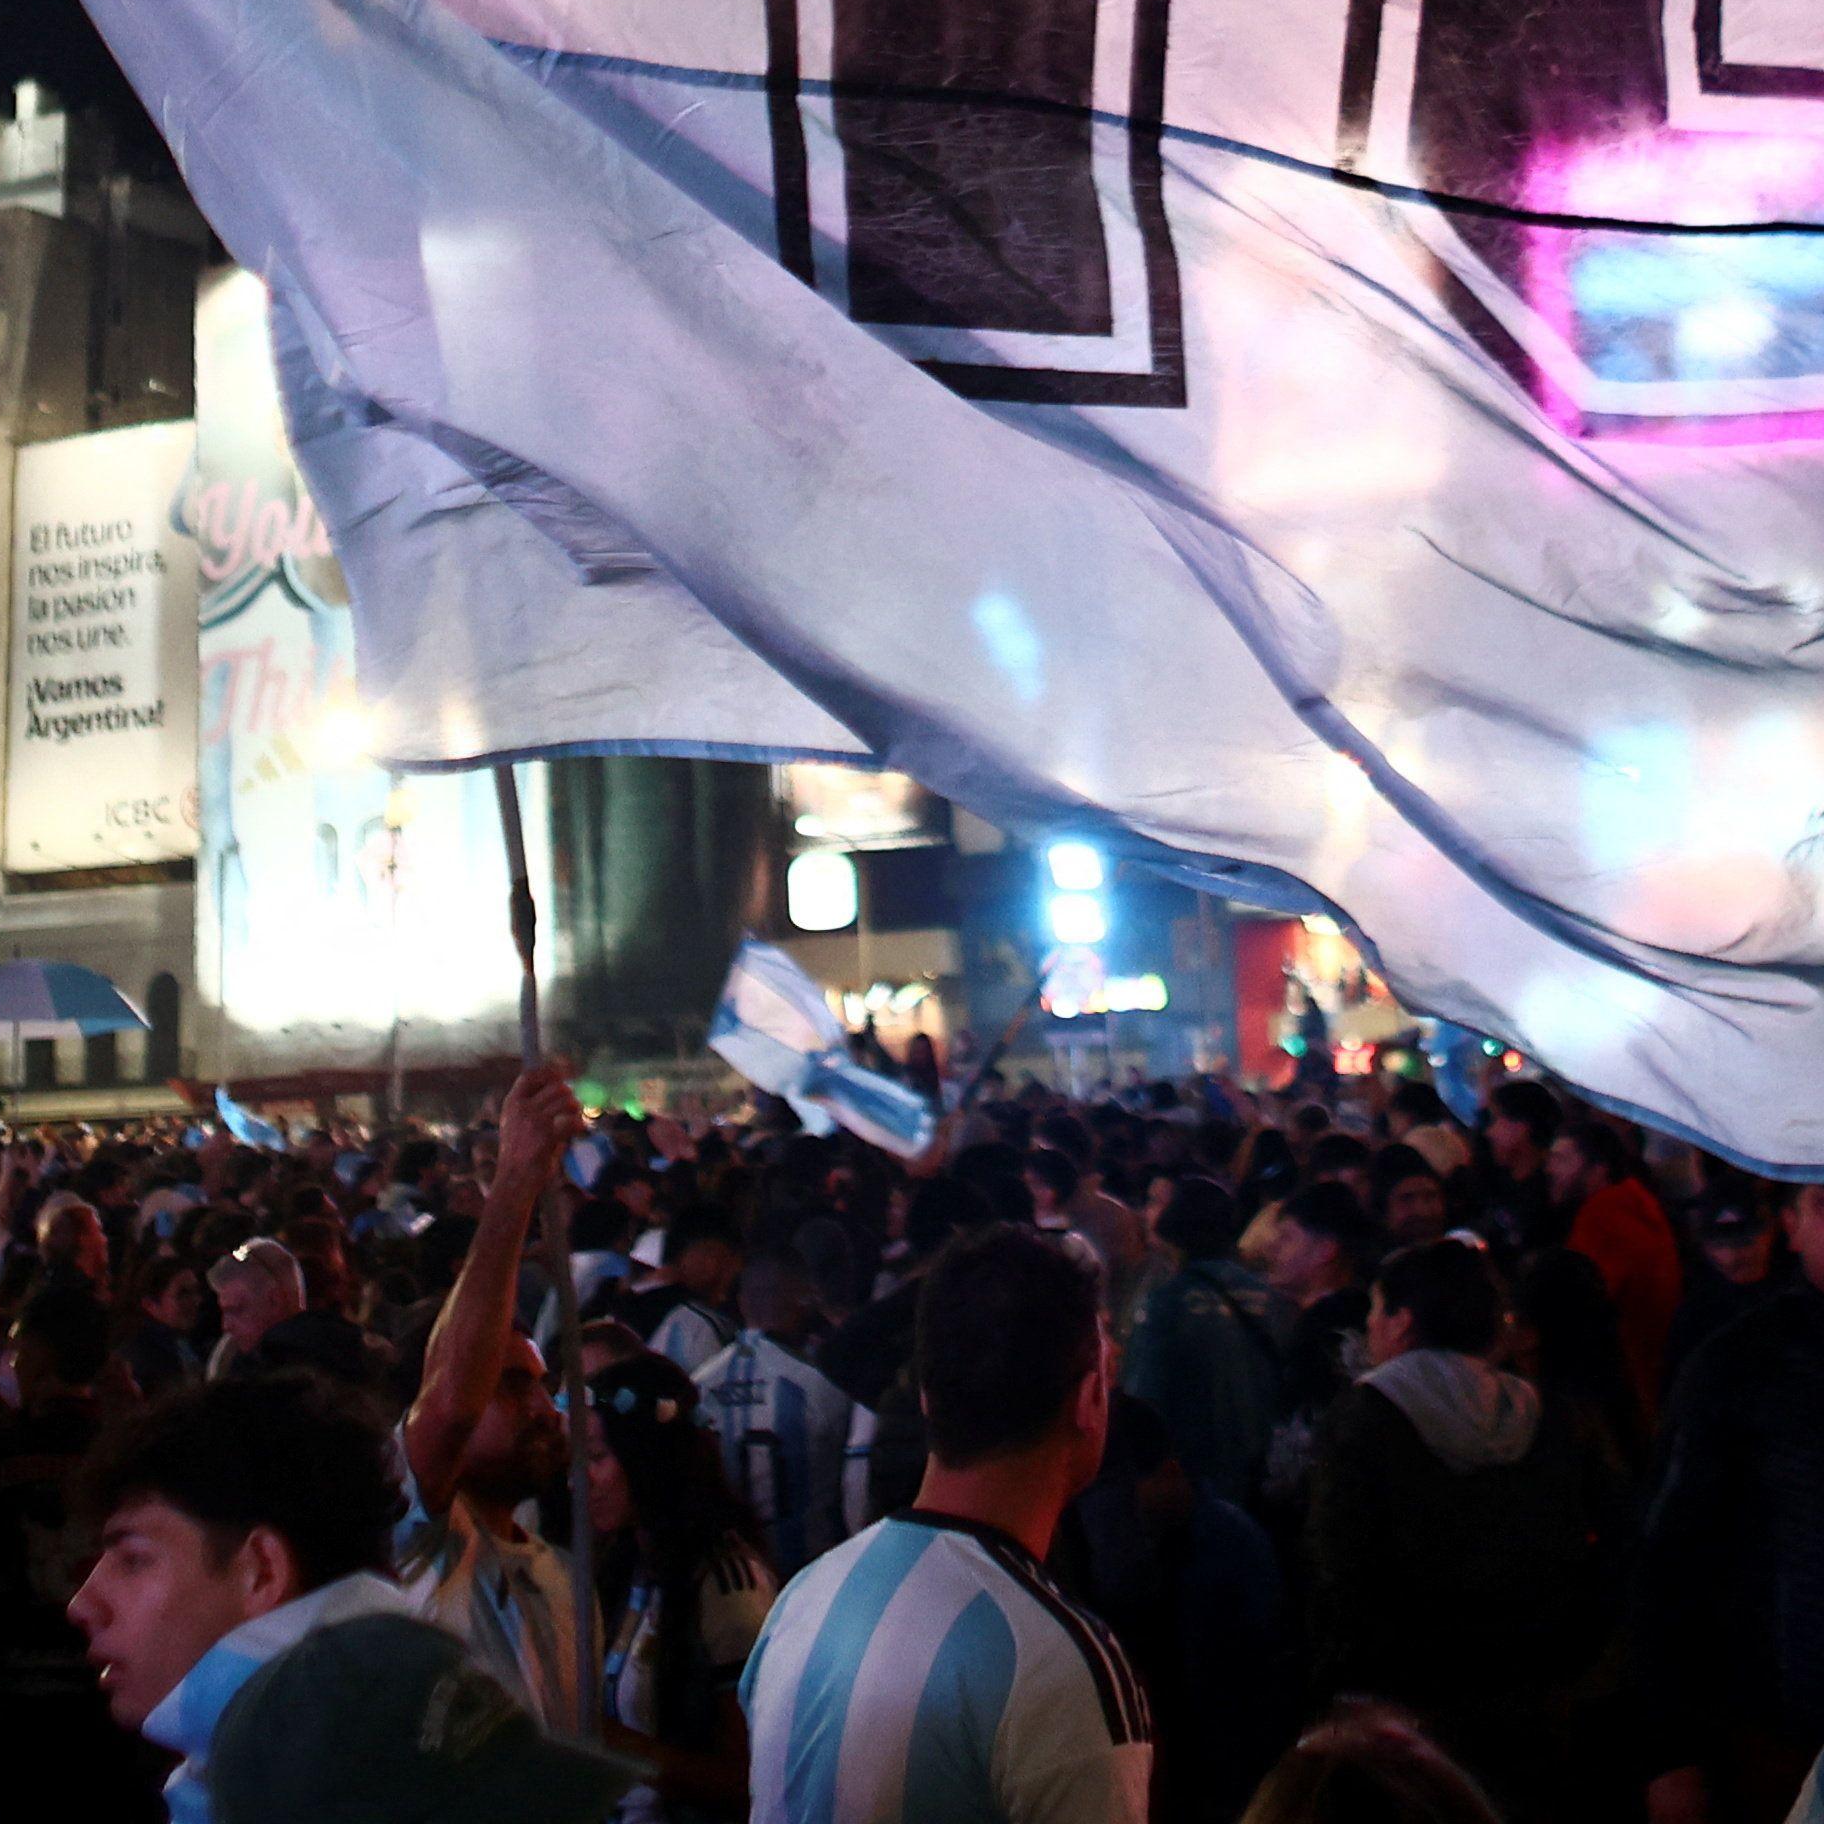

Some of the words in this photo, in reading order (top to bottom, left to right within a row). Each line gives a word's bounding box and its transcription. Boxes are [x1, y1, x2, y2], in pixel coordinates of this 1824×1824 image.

[29, 524, 49, 554] El
[55, 519, 132, 551] futuro
[28, 562, 74, 588] nos
[28, 595, 48, 622] la
[28, 631, 74, 655] nos
[25, 699, 165, 744] Argentina!
[105, 793, 170, 827] ICBC
